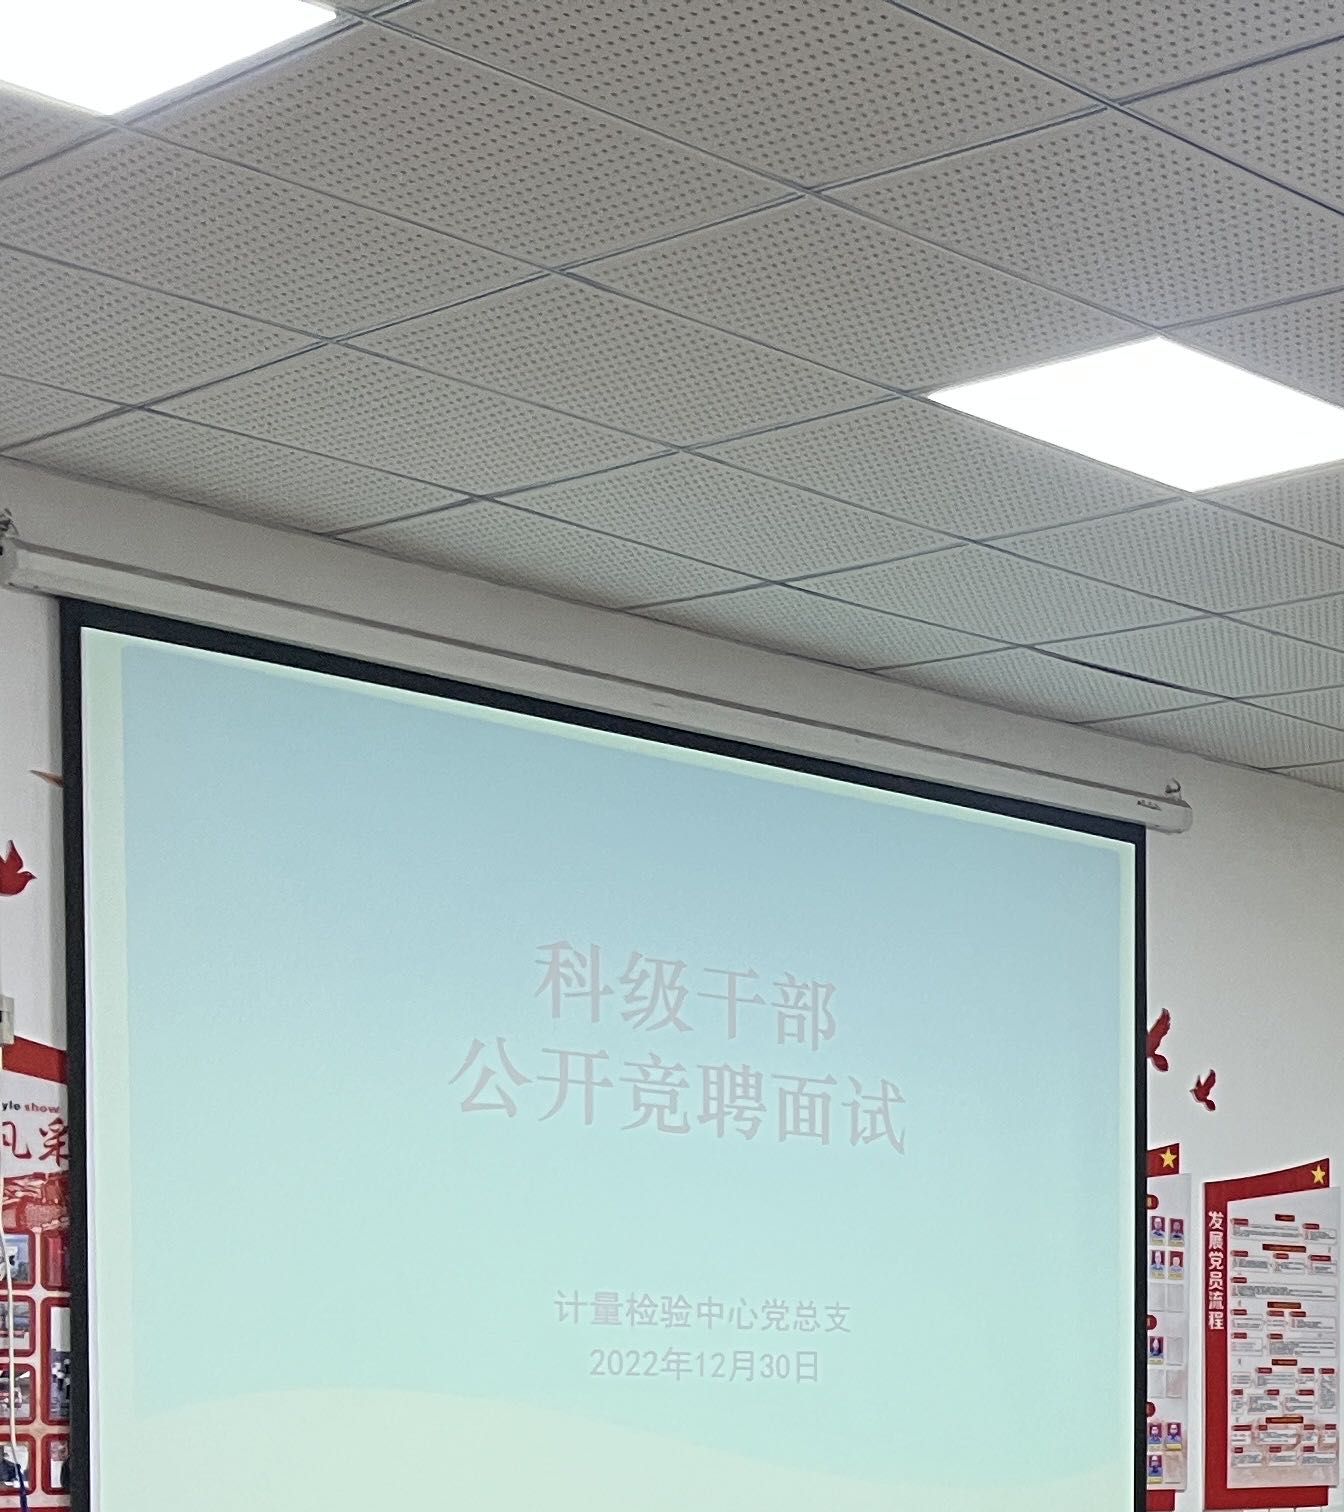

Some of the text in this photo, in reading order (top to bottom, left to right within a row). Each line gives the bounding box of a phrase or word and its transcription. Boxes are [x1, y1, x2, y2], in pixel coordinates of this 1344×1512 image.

[533, 938, 838, 1052] 科级干部
[25, 1103, 60, 1113] show
[447, 1035, 907, 1156] 公开竞聘面试
[1208, 1210, 1225, 1330] 发展党员流程
[553, 1288, 853, 1334] 计量检验中心党总支
[588, 1346, 821, 1383] 2022年12月30日
